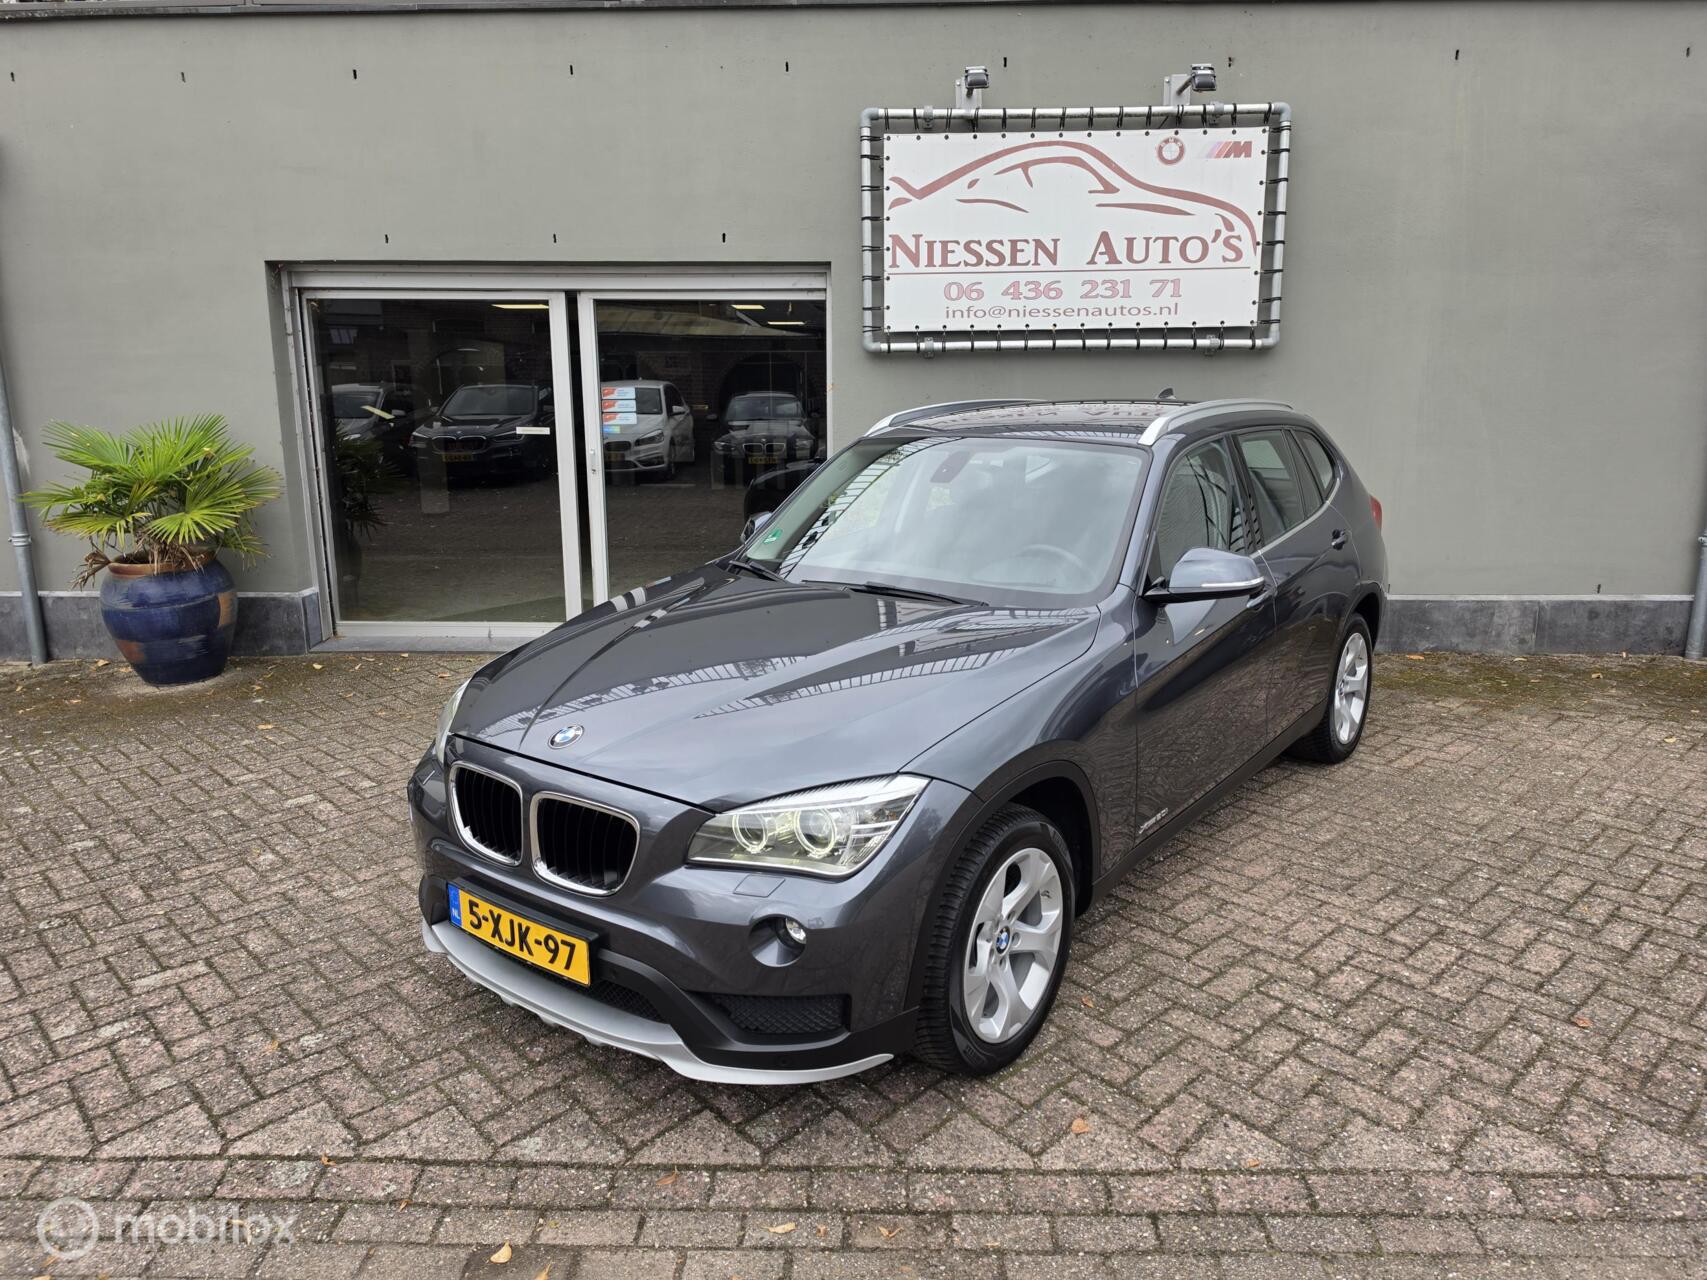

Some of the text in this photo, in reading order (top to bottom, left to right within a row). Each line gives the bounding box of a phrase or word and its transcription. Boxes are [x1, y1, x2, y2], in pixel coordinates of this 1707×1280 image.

[944, 278, 1182, 301] 06 436 231 71
[945, 302, 1179, 319] info@niessenautos.nl
[468, 899, 577, 971] 5-XJK-97
